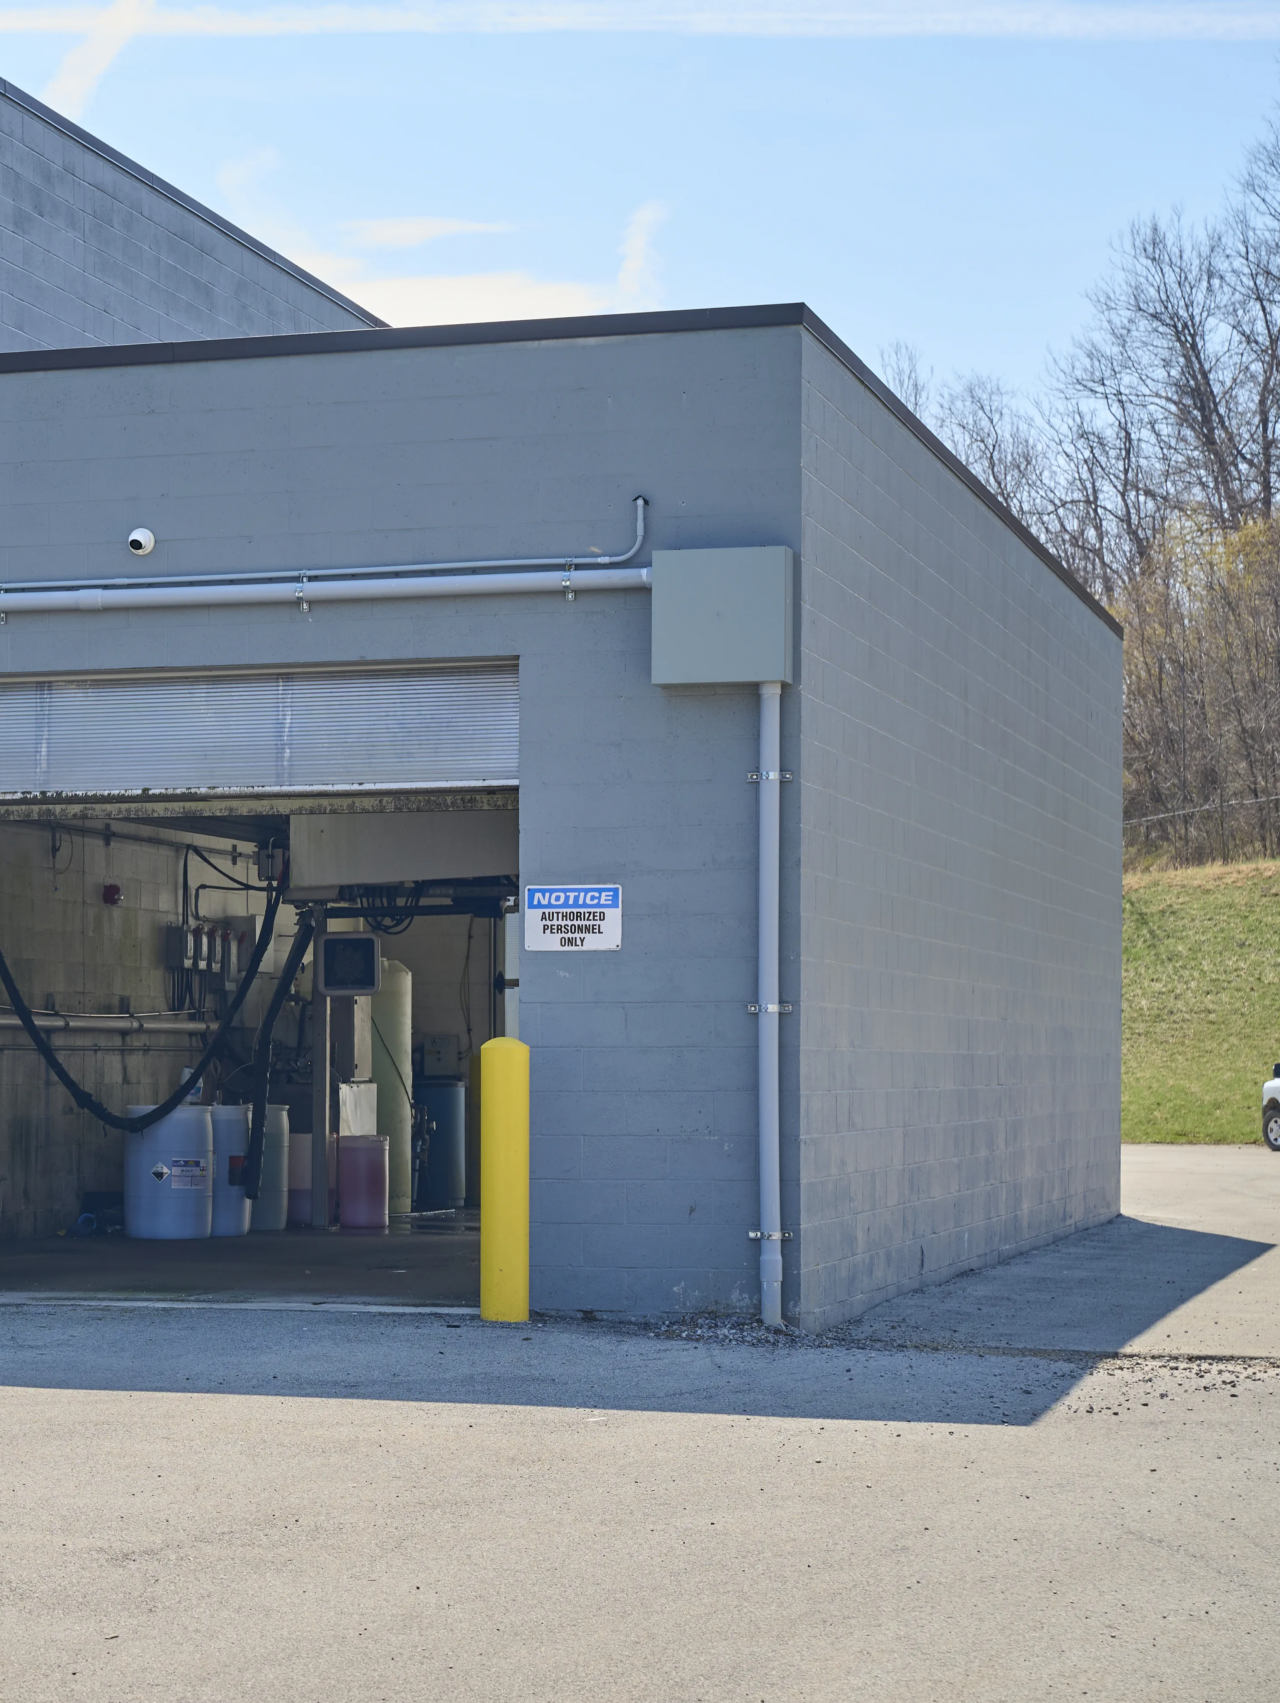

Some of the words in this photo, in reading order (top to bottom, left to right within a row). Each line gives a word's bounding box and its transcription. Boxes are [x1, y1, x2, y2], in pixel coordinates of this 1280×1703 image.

[533, 891, 614, 905] NOTICE
[540, 911, 606, 922] AUTHORIZED
[542, 924, 604, 935] PERSONNEL
[559, 936, 586, 948] ONLY
